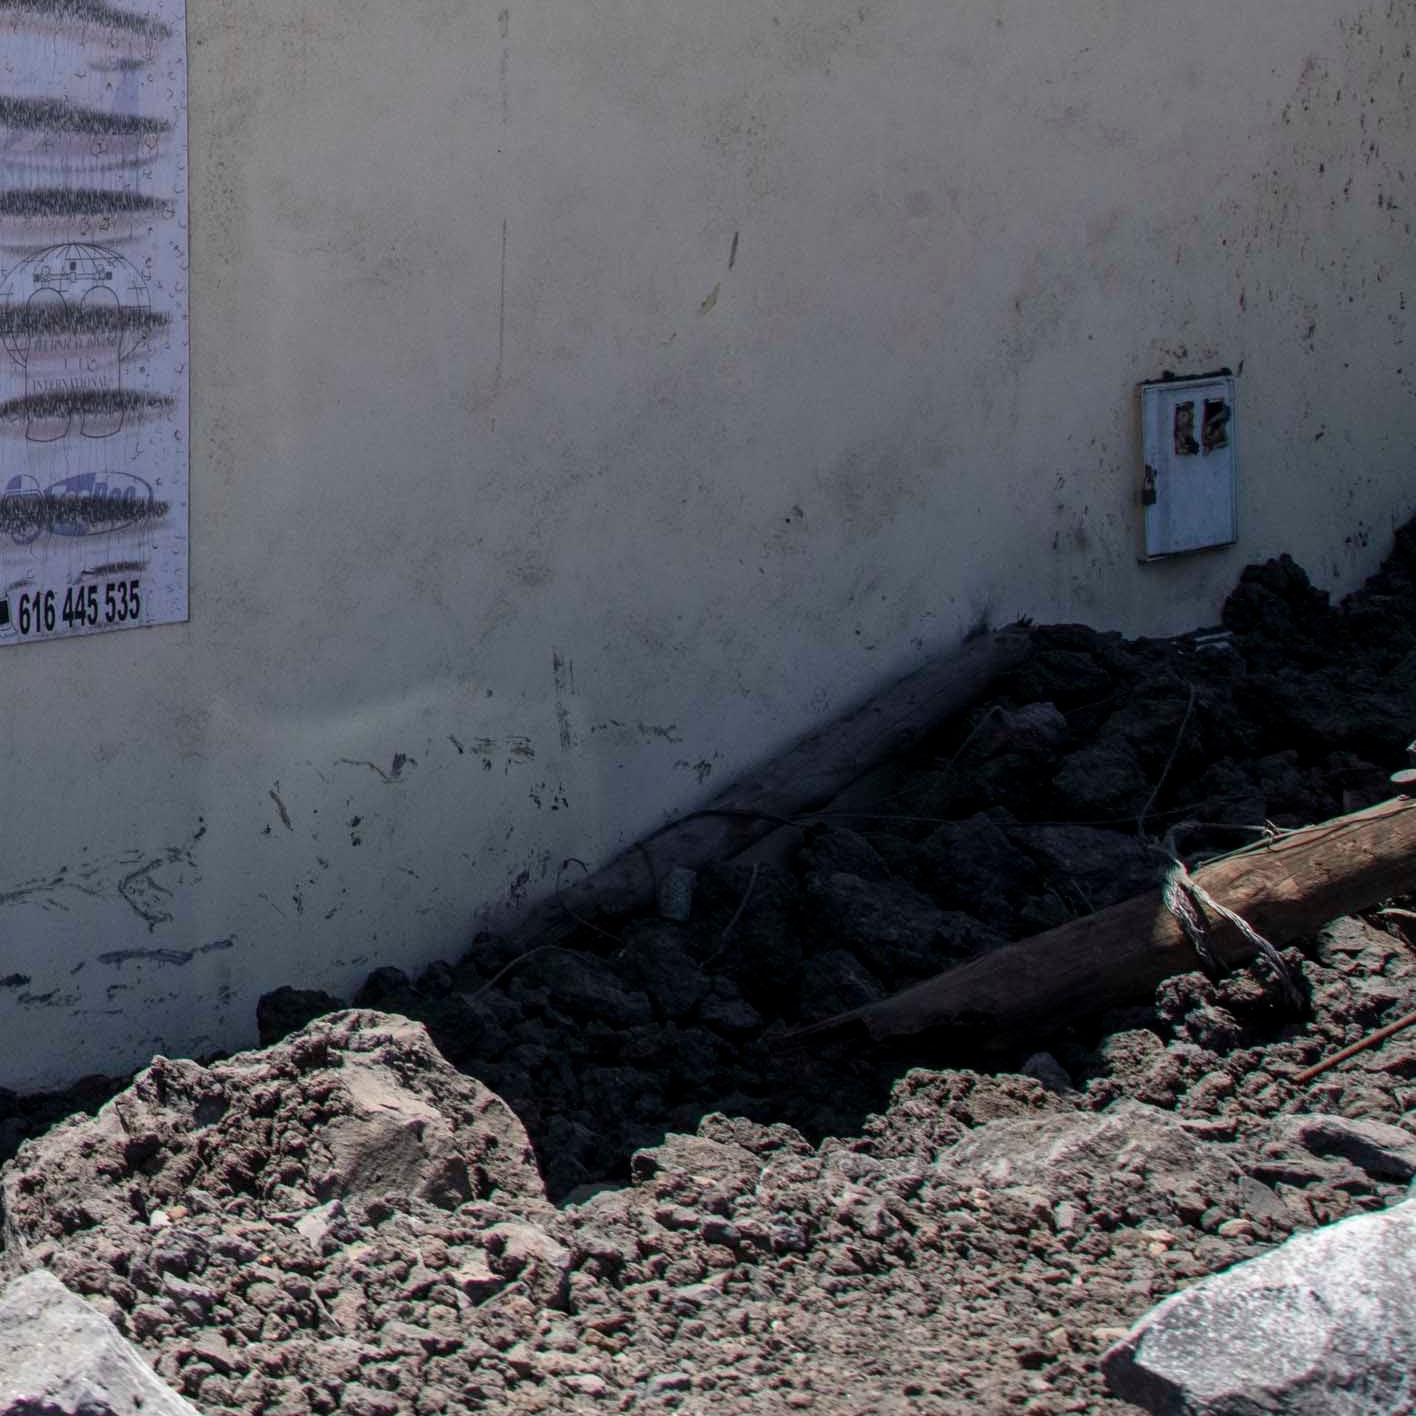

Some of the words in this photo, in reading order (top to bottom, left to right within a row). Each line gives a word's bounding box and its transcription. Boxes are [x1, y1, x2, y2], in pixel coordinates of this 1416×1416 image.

[18, 586, 56, 635] 616
[61, 585, 99, 628] 445
[104, 579, 142, 624] 535
